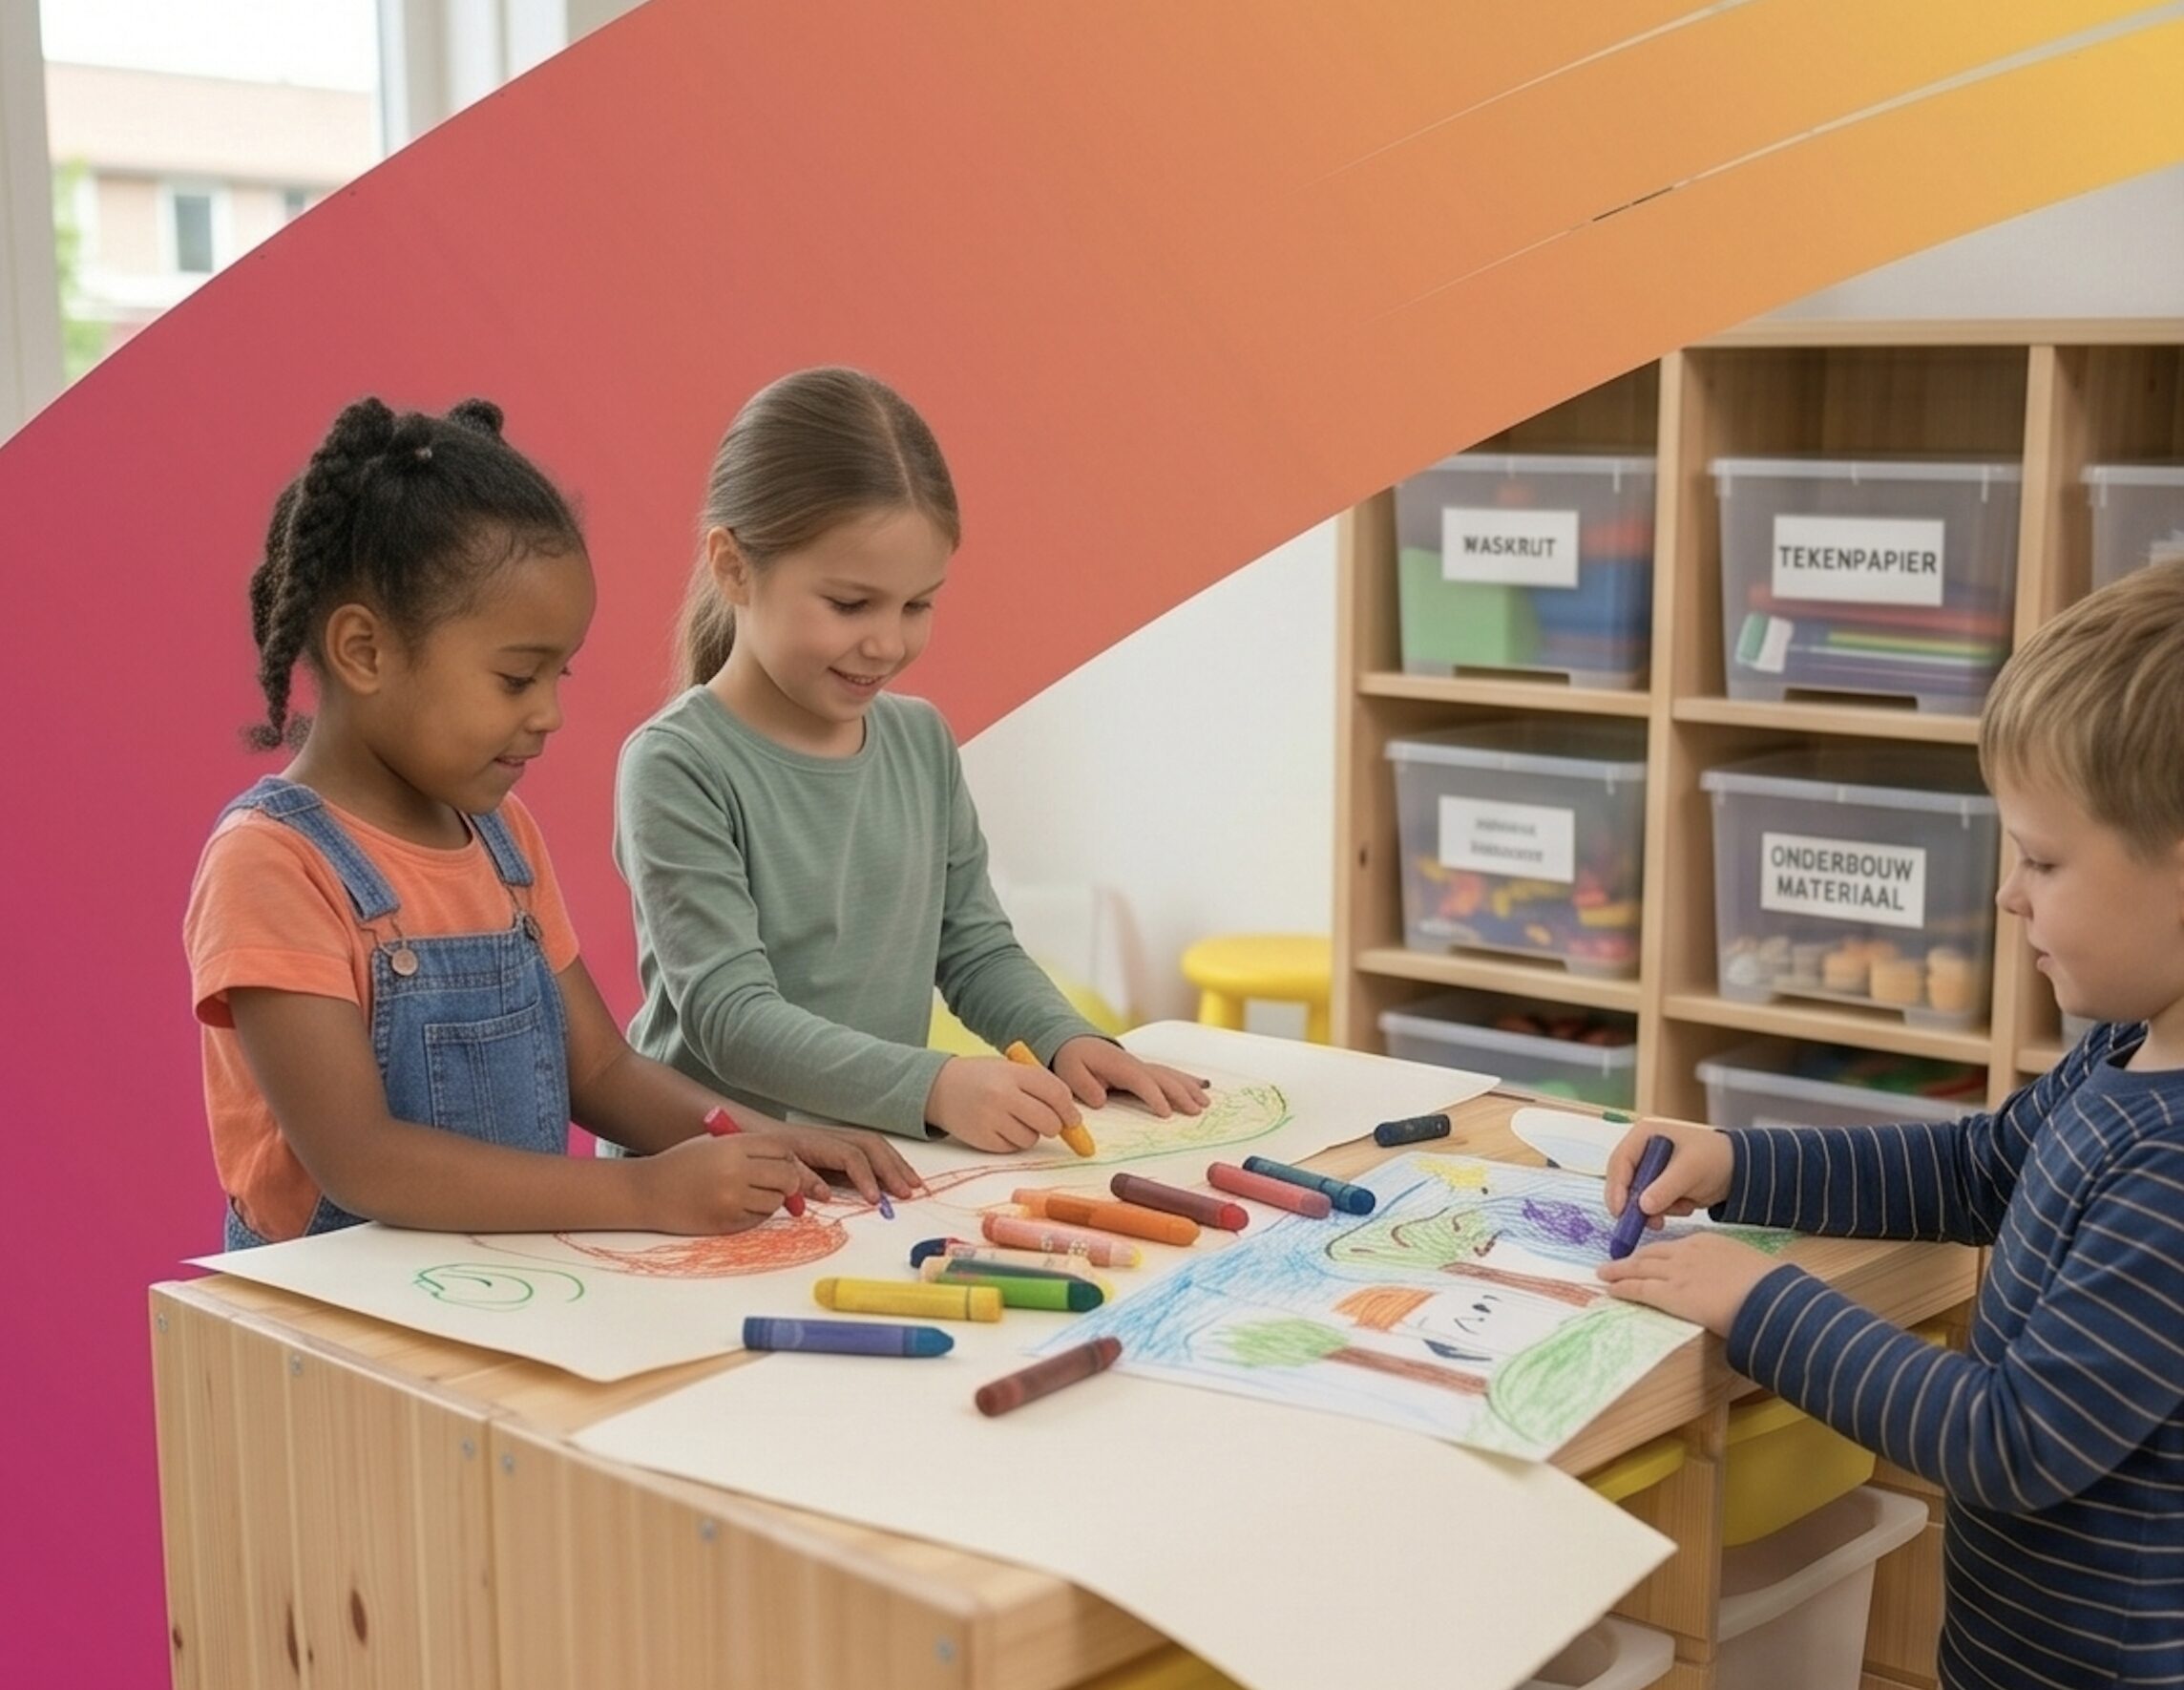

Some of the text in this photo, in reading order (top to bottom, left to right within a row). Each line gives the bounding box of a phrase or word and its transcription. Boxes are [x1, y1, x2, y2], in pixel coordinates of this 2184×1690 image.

[1779, 545, 1937, 574] TEKENPAPIER
[1771, 846, 1913, 881] ONDERBOUW
[1777, 876, 1904, 911] MATERIAAL
